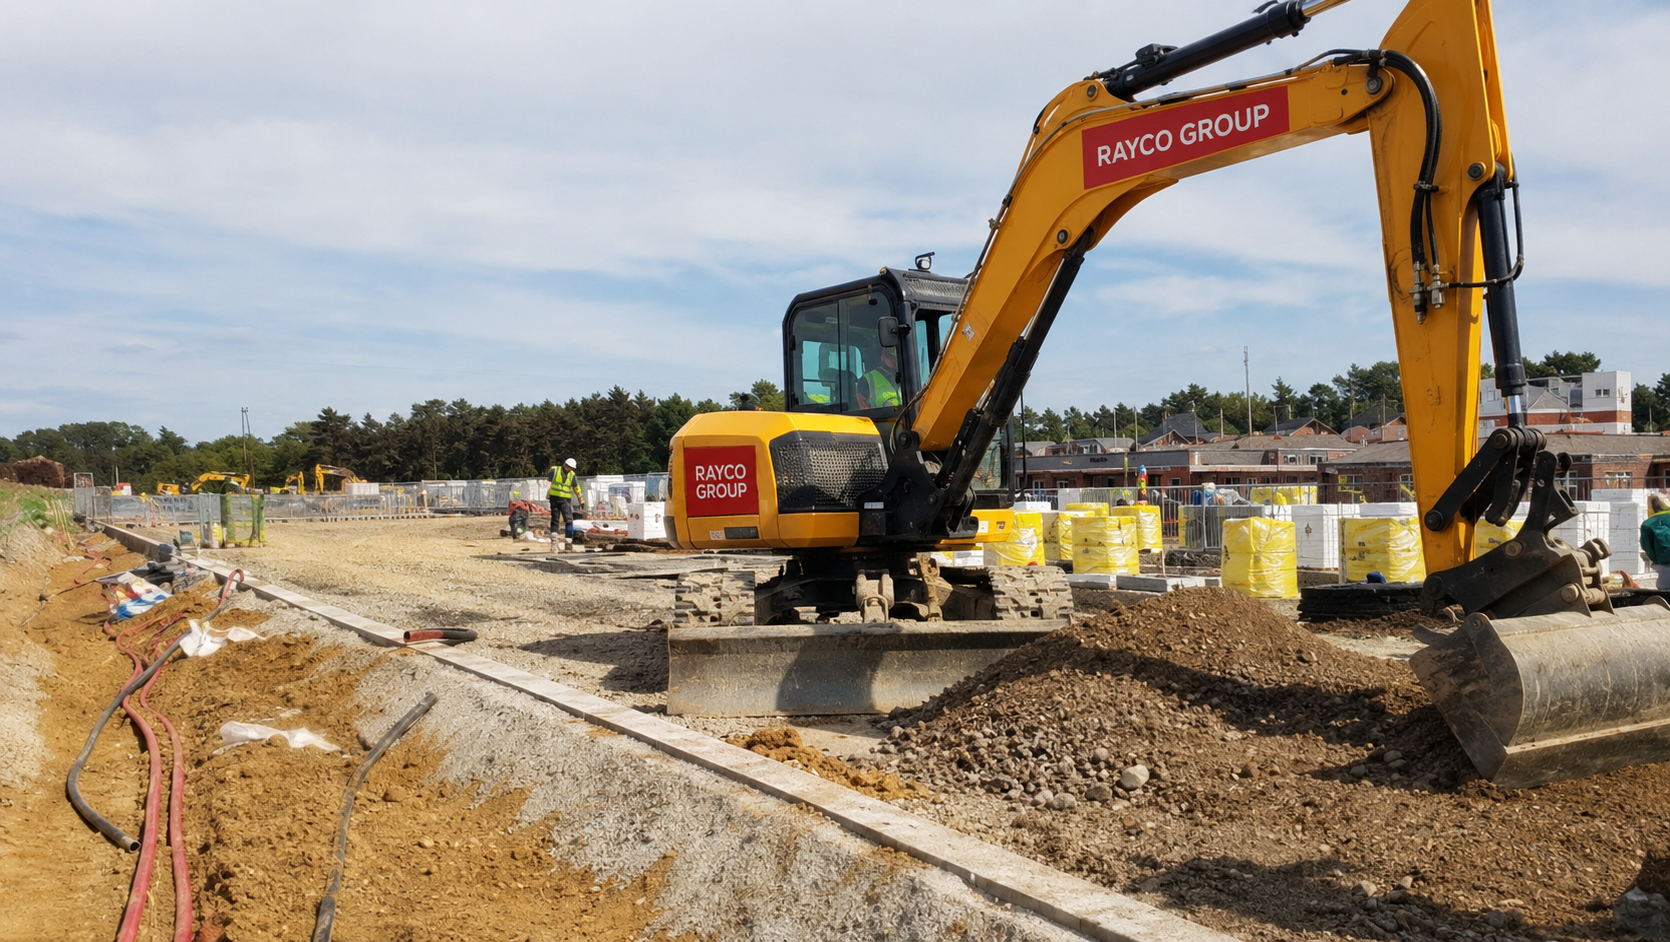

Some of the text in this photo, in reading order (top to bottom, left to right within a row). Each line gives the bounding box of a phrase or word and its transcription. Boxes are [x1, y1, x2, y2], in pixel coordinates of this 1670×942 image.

[1097, 103, 1270, 167] RAYCO GROUP
[695, 463, 747, 482] RAYCO
[696, 482, 747, 500] GROUP
